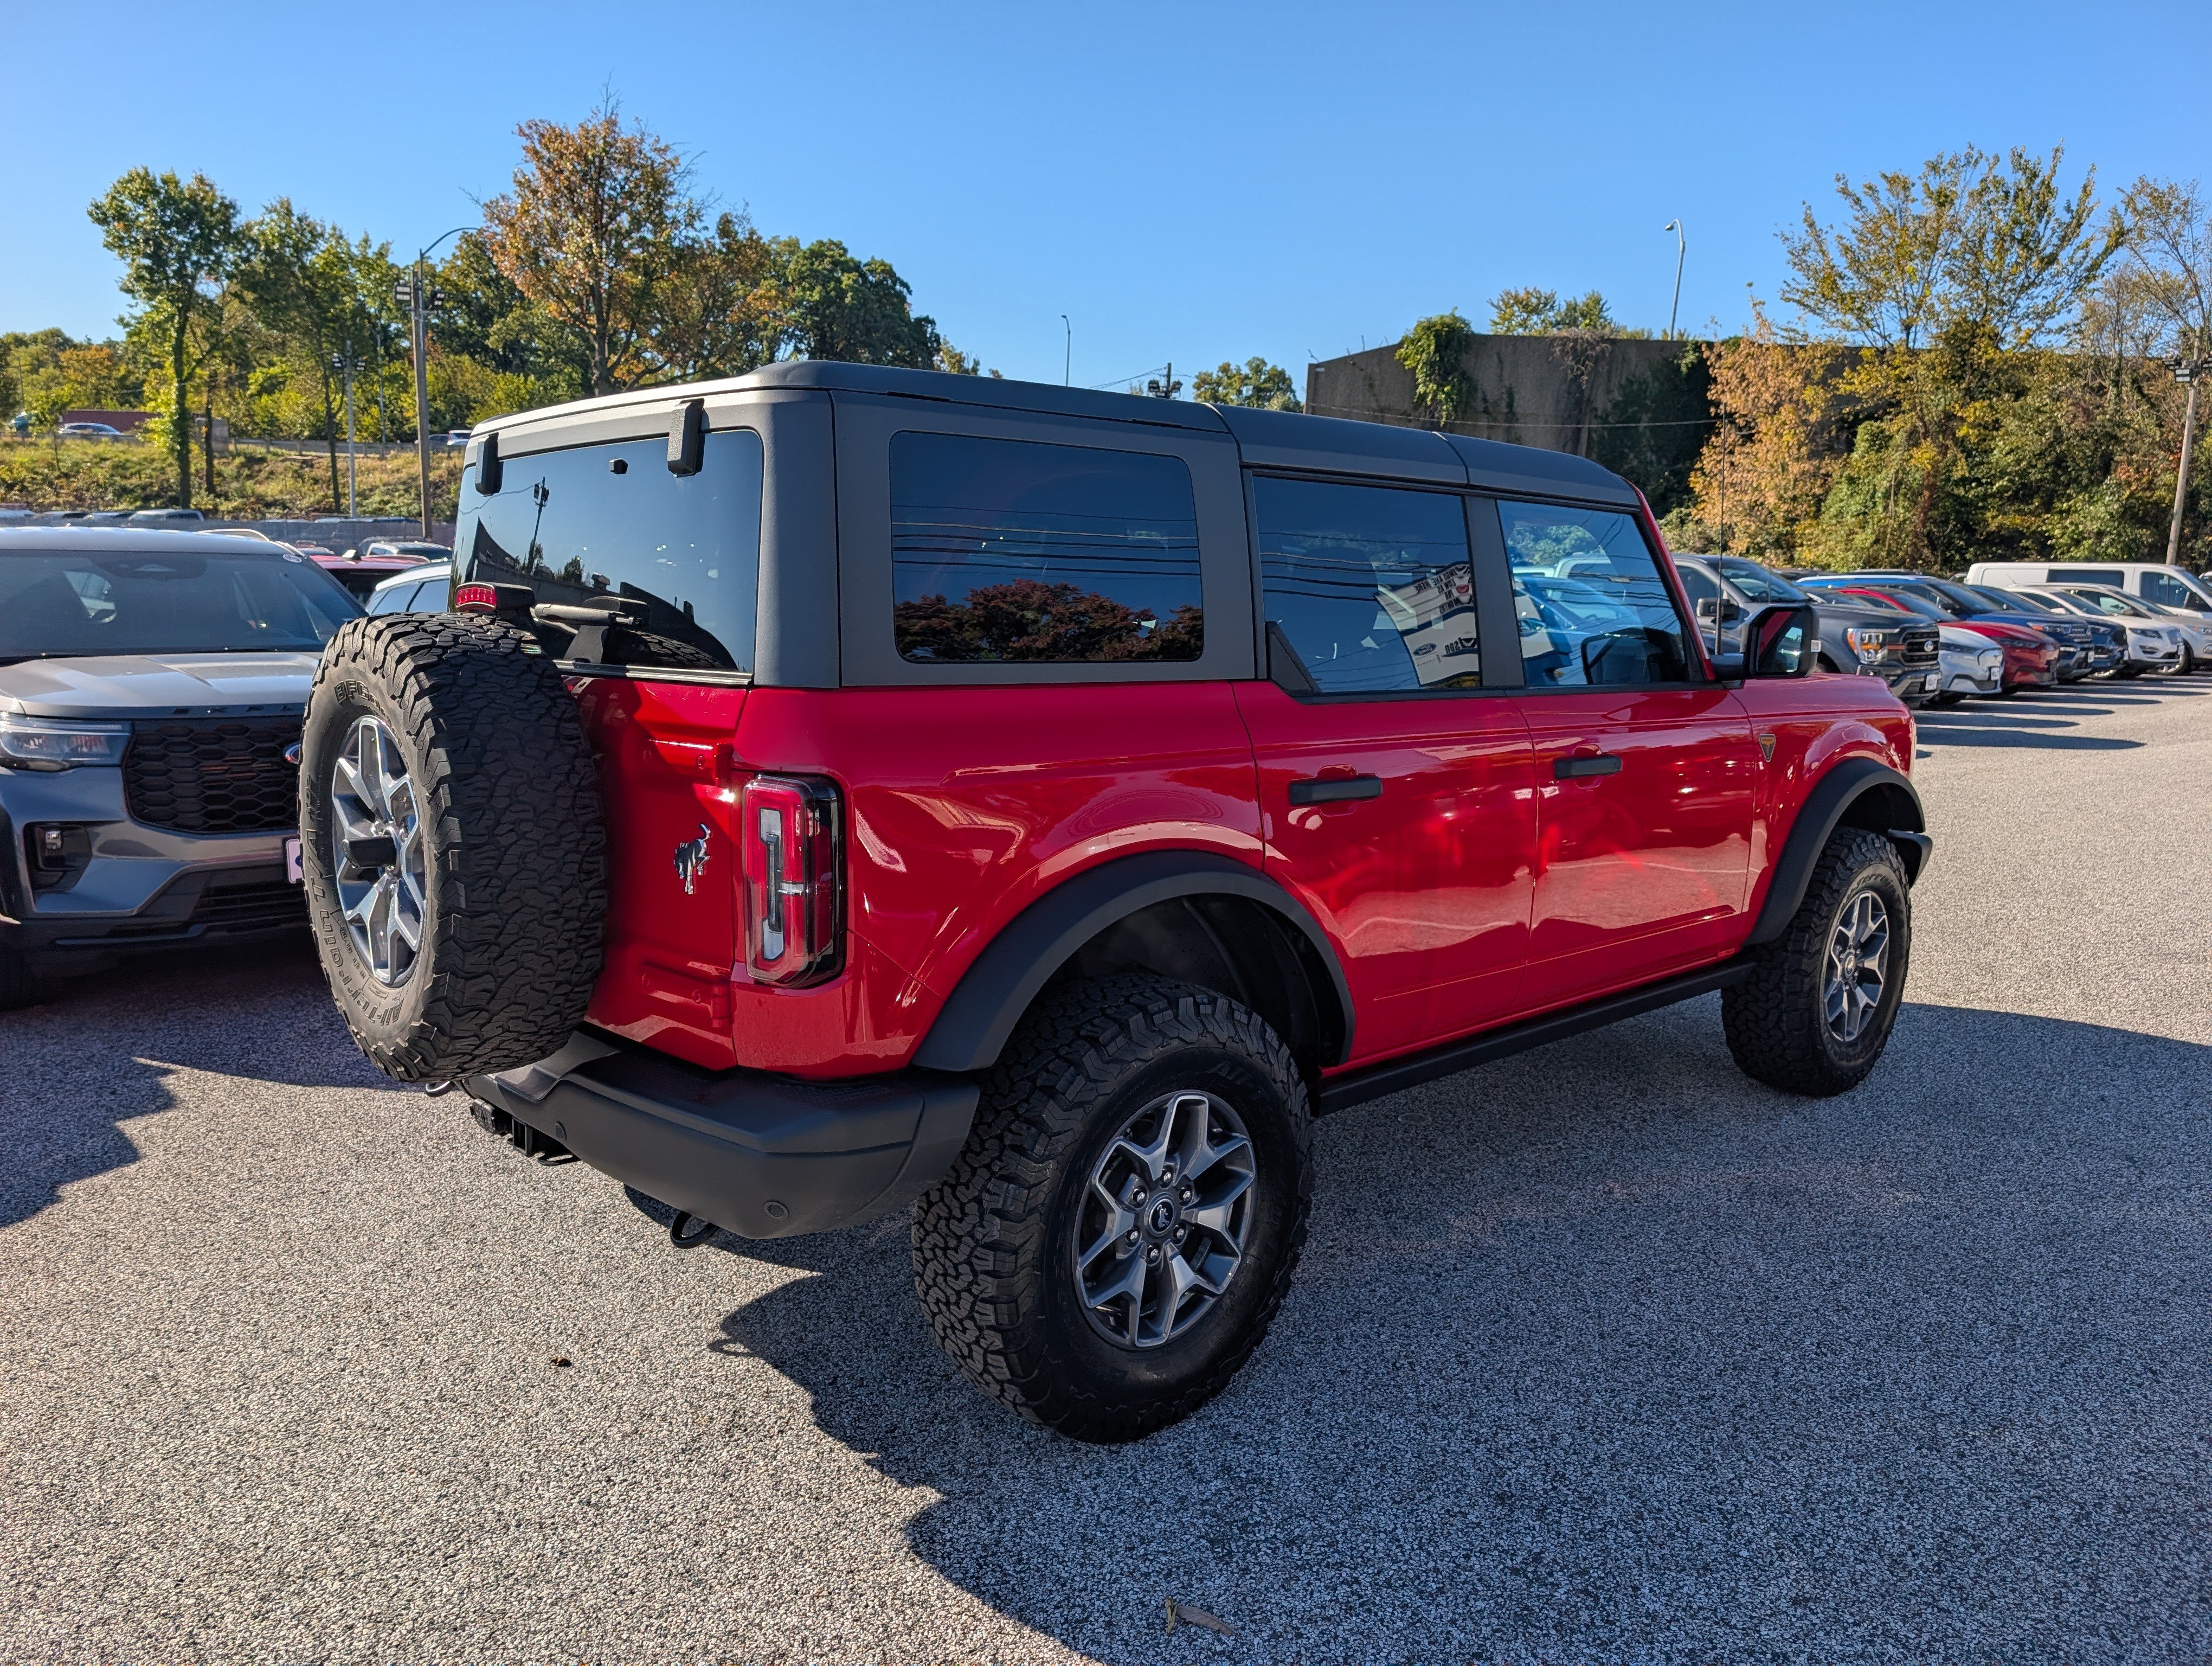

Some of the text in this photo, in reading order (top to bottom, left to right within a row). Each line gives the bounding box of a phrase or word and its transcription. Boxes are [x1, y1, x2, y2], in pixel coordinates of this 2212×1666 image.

[172, 704, 294, 715] EXPL
[306, 829, 326, 902] T/A
[319, 909, 404, 1026] All-Terrain
